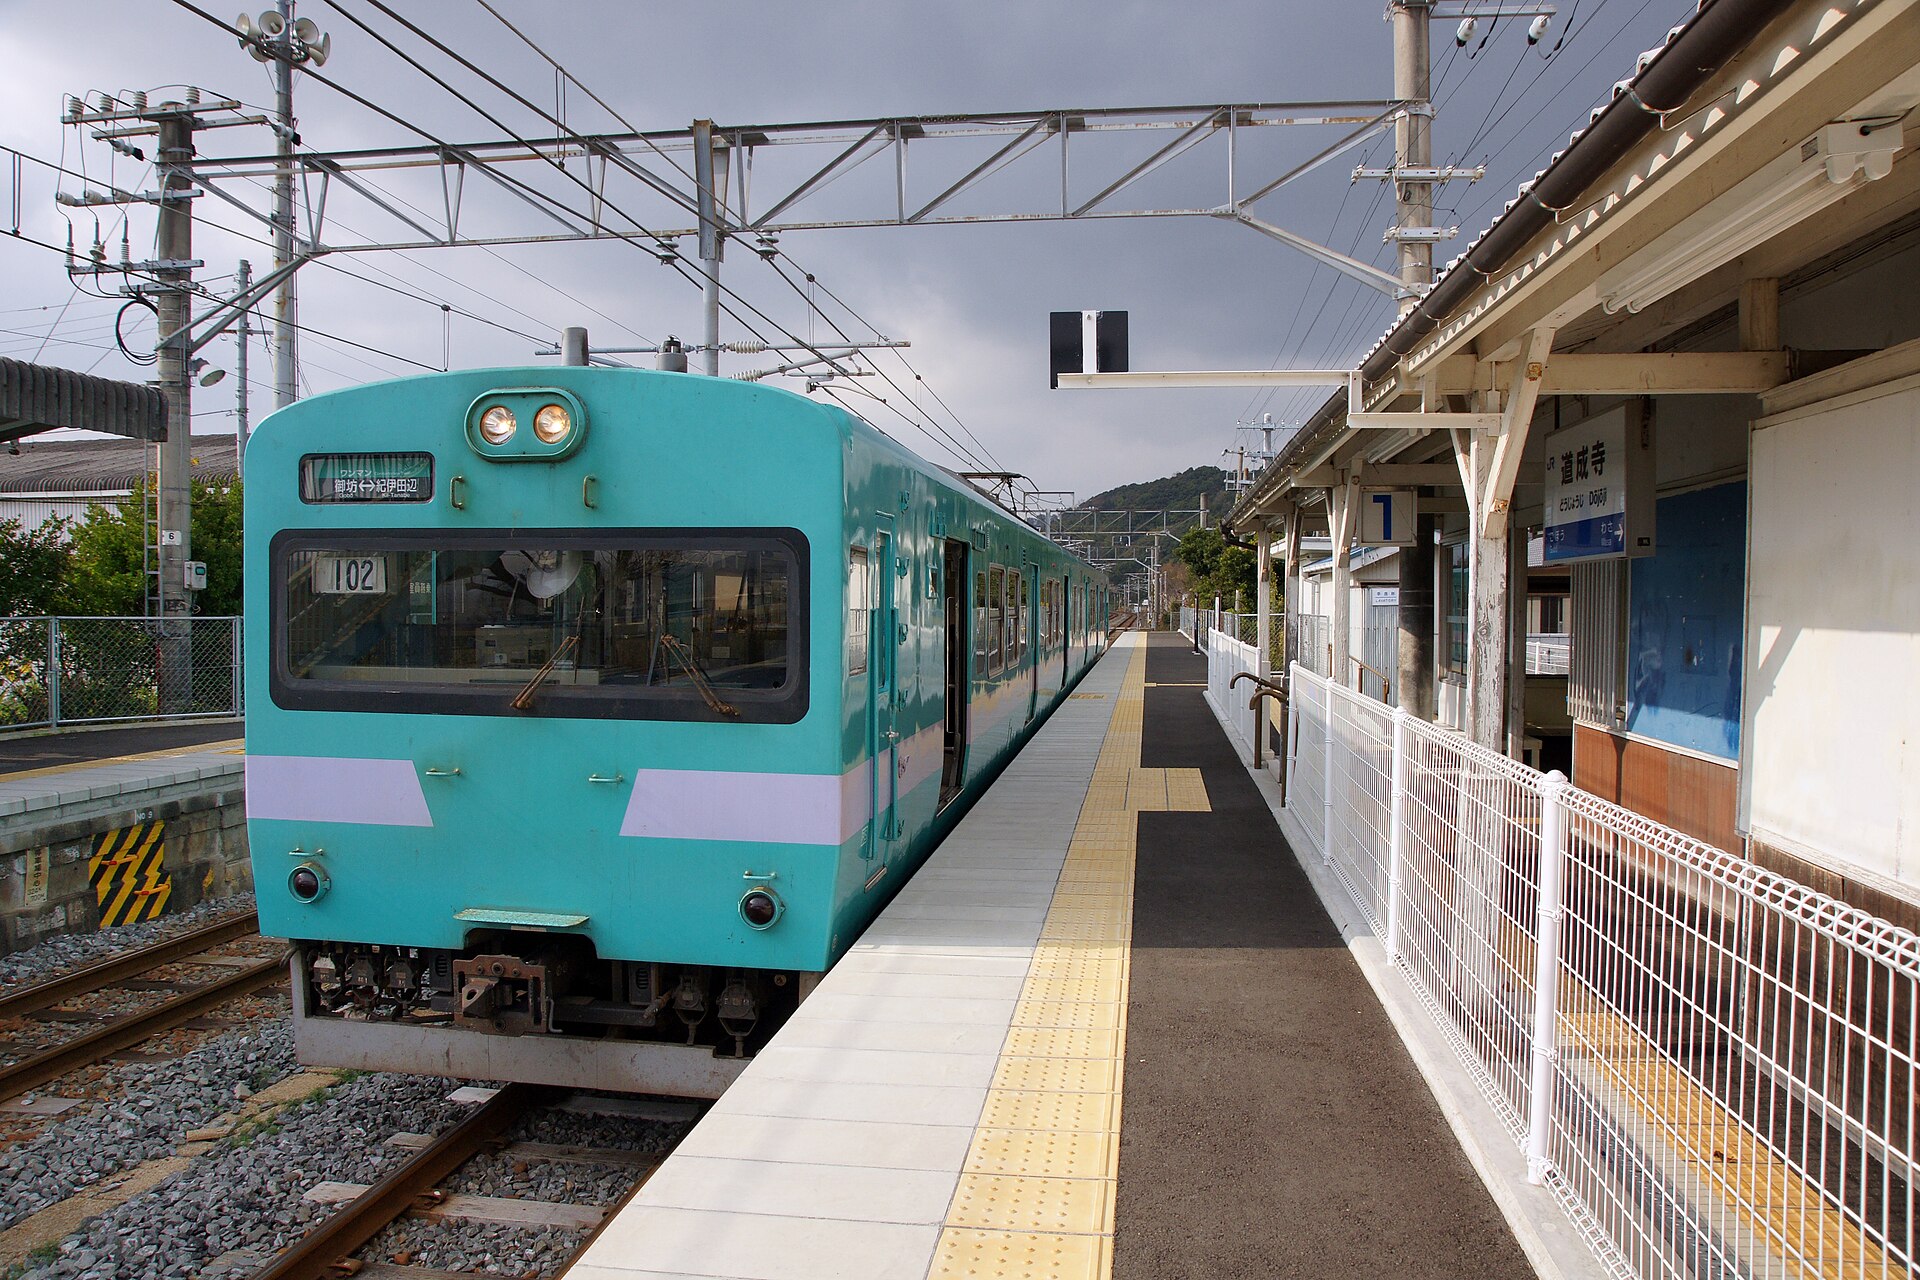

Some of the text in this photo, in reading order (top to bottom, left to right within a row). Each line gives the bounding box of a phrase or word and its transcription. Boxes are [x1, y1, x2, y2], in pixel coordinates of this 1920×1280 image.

[340, 469, 372, 478] ワンマン
[1547, 440, 1605, 485] JR 道成寺
[335, 479, 417, 493] 御坊 紀伊田辺
[1373, 495, 1392, 540] 1
[1601, 522, 1613, 535] わさ
[336, 560, 374, 591] 102
